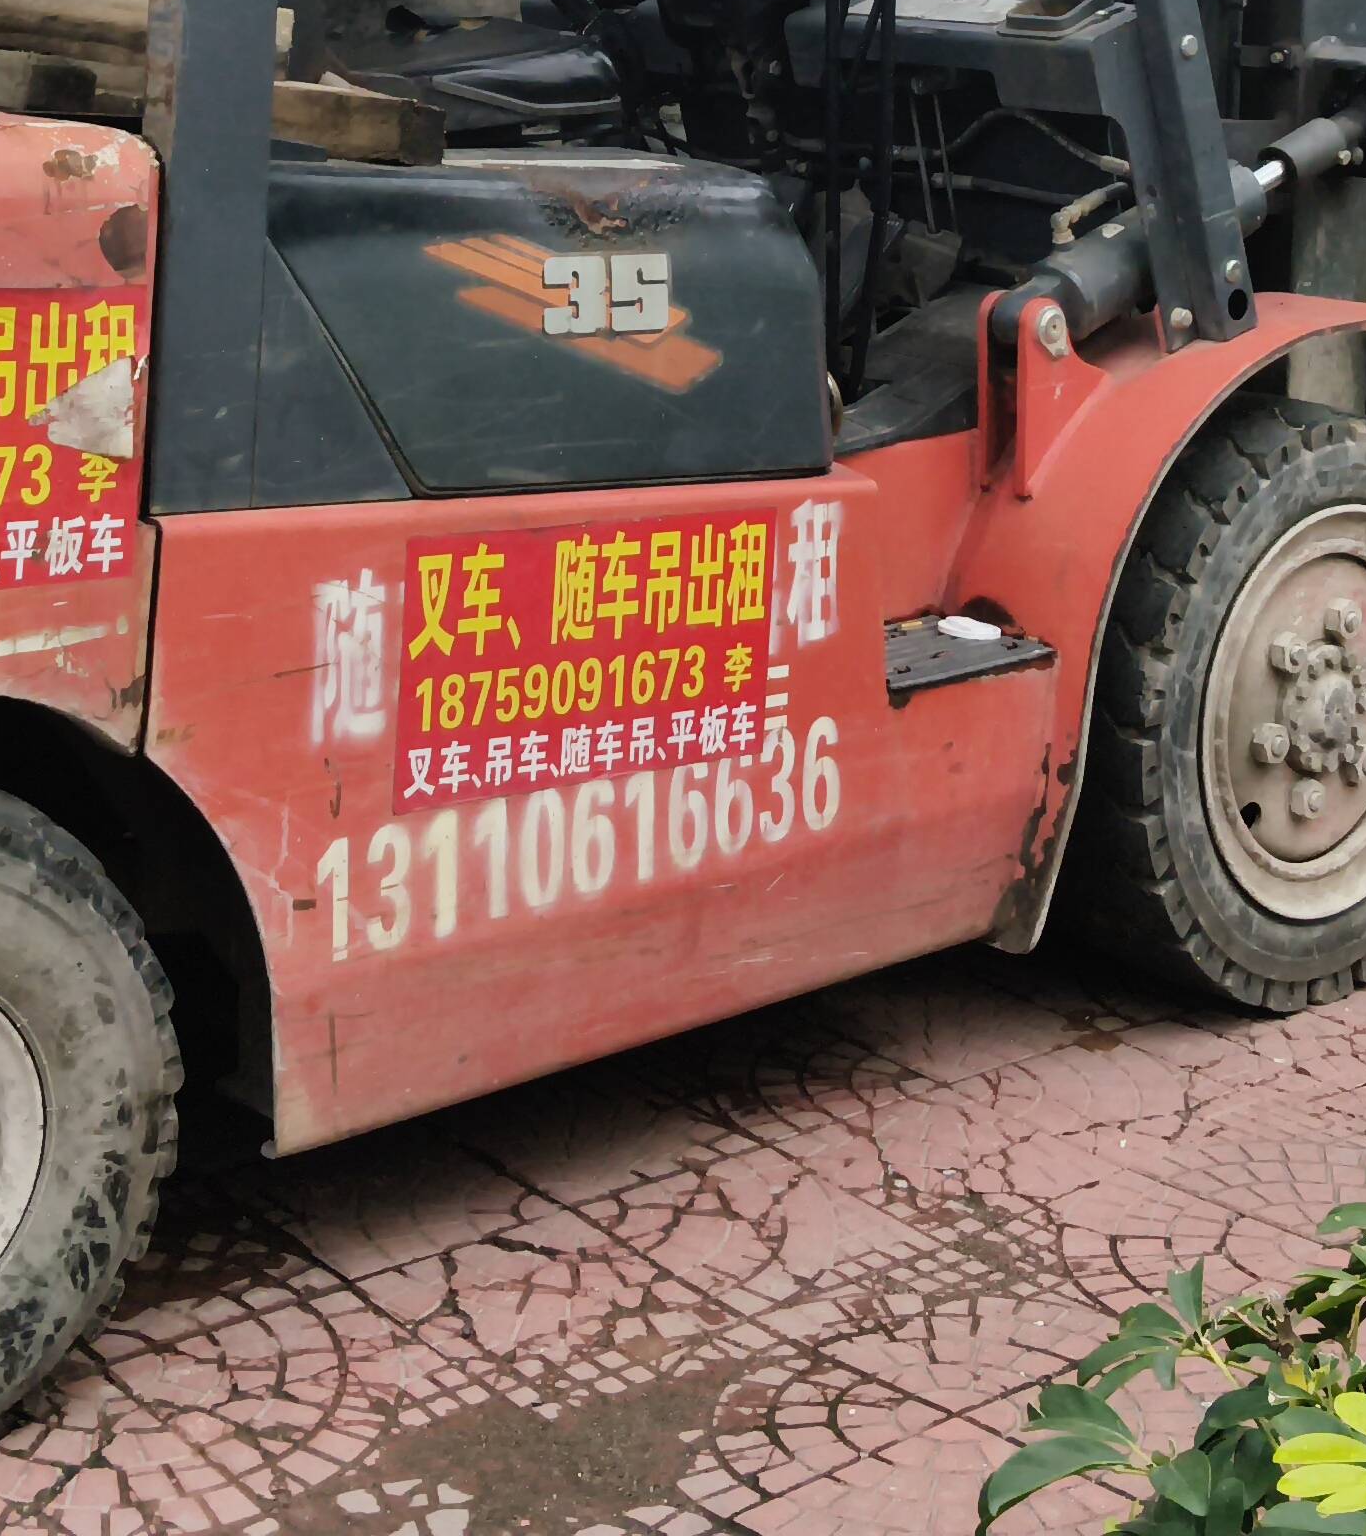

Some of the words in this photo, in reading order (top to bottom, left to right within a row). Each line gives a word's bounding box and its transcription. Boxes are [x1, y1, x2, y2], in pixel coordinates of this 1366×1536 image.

[542, 253, 669, 335] 35
[77, 451, 119, 503] 李
[415, 645, 705, 732] 18759091673
[723, 642, 753, 693] 李
[316, 716, 842, 963] 13110616636
